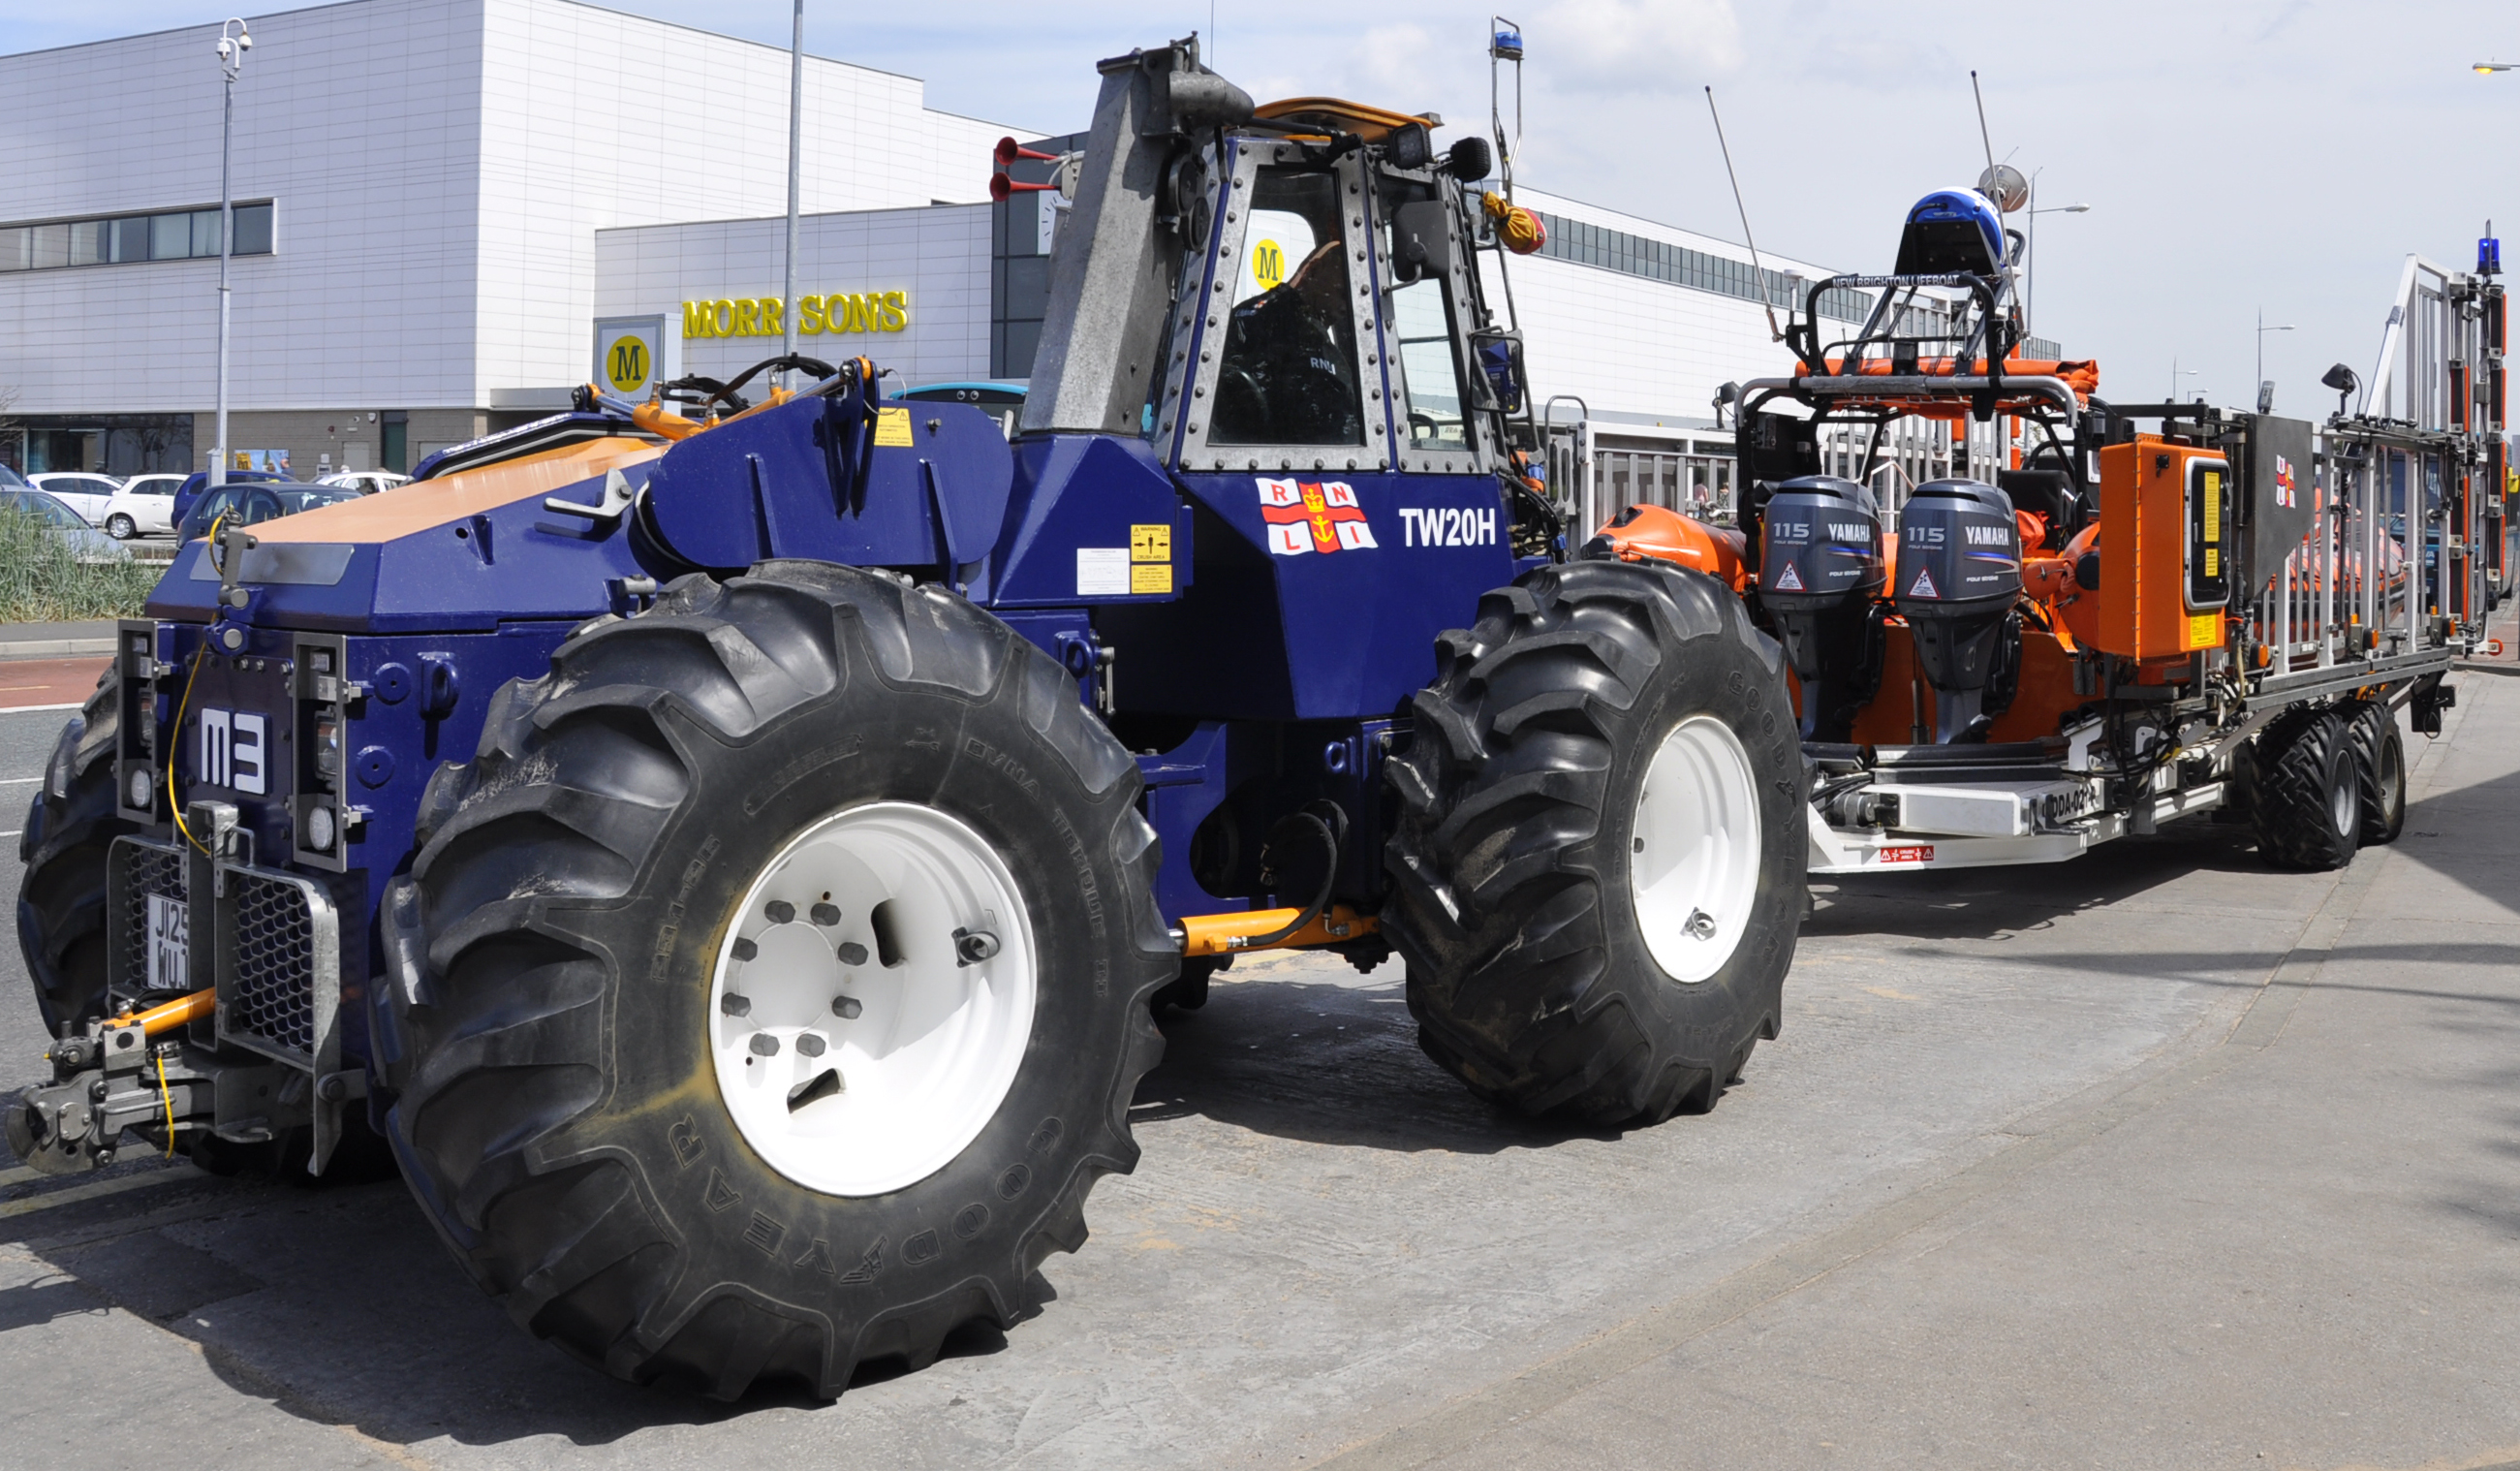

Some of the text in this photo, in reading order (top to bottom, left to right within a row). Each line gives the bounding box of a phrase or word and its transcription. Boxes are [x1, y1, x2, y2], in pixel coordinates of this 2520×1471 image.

[1258, 246, 1279, 281] M
[1832, 274, 1960, 289] NEW BRIGHTON LIFEBOAT
[682, 291, 909, 339] MORRSONS
[614, 345, 641, 382] M
[1310, 357, 1336, 375] RNLI
[1270, 484, 1349, 503] R N
[1398, 508, 1496, 548] TW20H
[1773, 522, 1810, 538] 115
[1827, 522, 1871, 543] YAMAHA
[1908, 526, 1945, 543] 115
[1965, 525, 2009, 547] YAMAHA
[1283, 530, 1301, 550] L
[201, 707, 265, 795] M3
[155, 900, 189, 947] J125
[667, 1113, 1064, 1285] GOODYEAR
